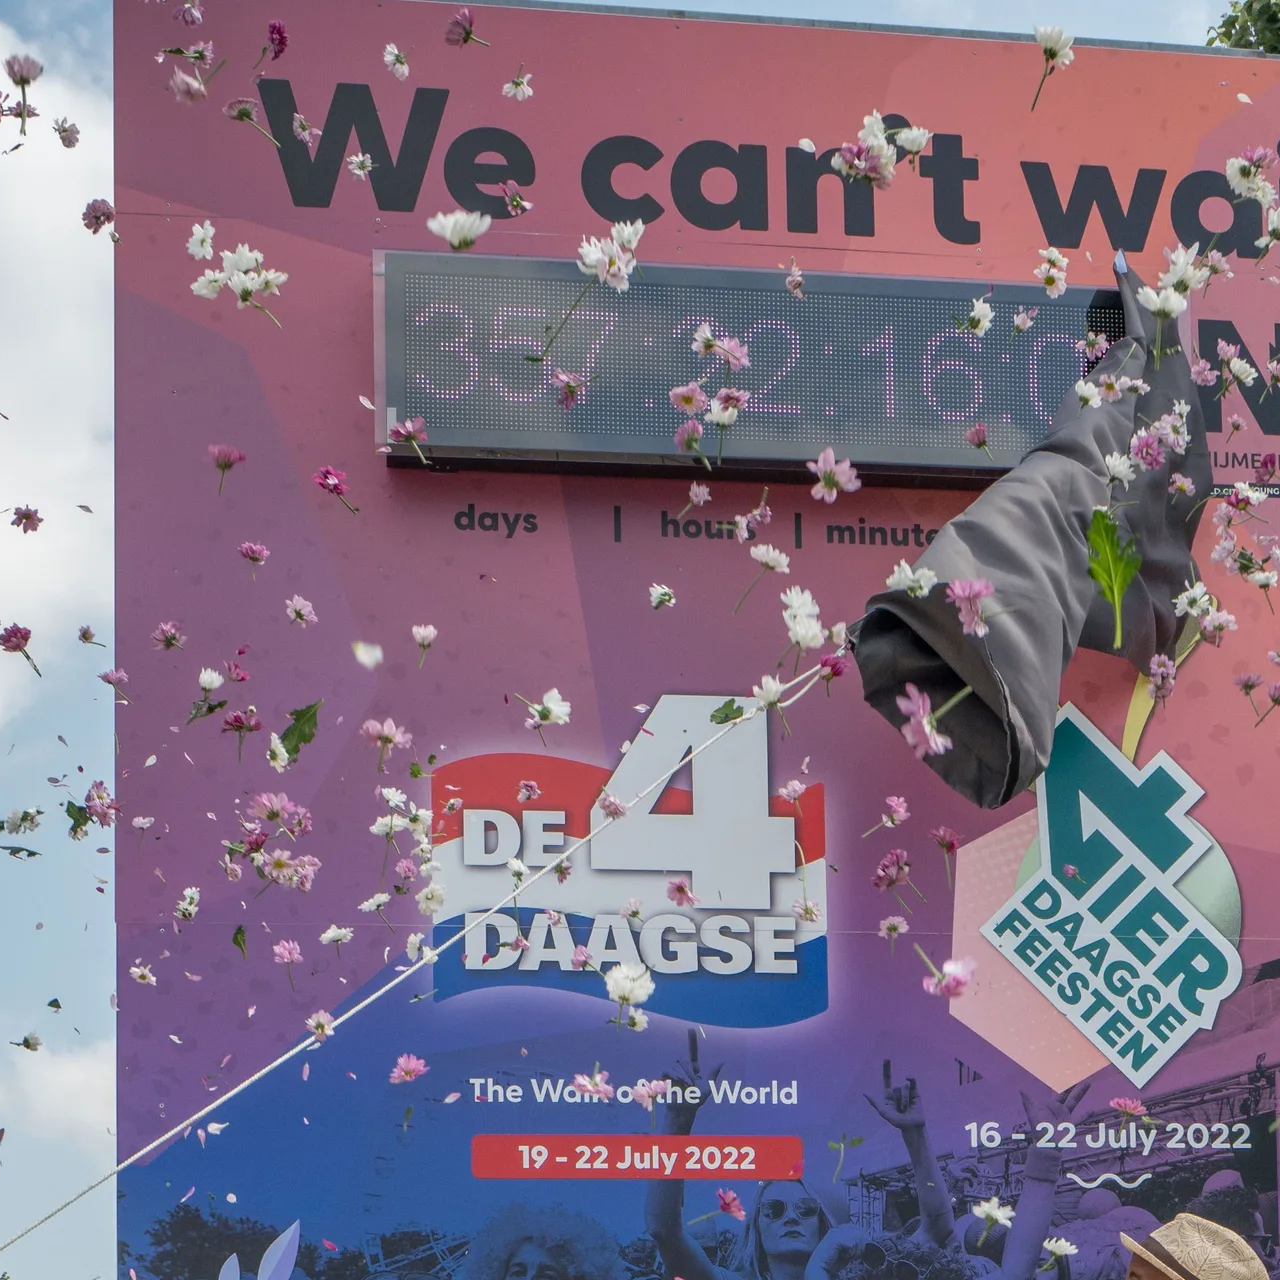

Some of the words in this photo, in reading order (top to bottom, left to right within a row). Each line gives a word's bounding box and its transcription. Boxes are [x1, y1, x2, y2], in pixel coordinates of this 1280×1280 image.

[257, 78, 538, 221] We
[580, 112, 982, 246] can't
[453, 503, 539, 538] days
[826, 516, 940, 548] minute
[462, 809, 567, 867] DE
[590, 694, 797, 910] 4
[464, 912, 798, 976] DAAGSE
[1020, 878, 1188, 1045] DAAGSE
[992, 907, 1160, 1073] FEESTEN
[469, 1078, 523, 1104] The
[708, 1079, 799, 1105] World
[518, 1145, 549, 1169] 19
[575, 1145, 609, 1169] 22
[616, 1145, 679, 1175] July
[685, 1146, 756, 1170] 2022
[964, 1121, 1002, 1148] 16
[1035, 1121, 1077, 1149] 22
[1085, 1121, 1158, 1156] July
[1166, 1122, 1253, 1149] 2022
